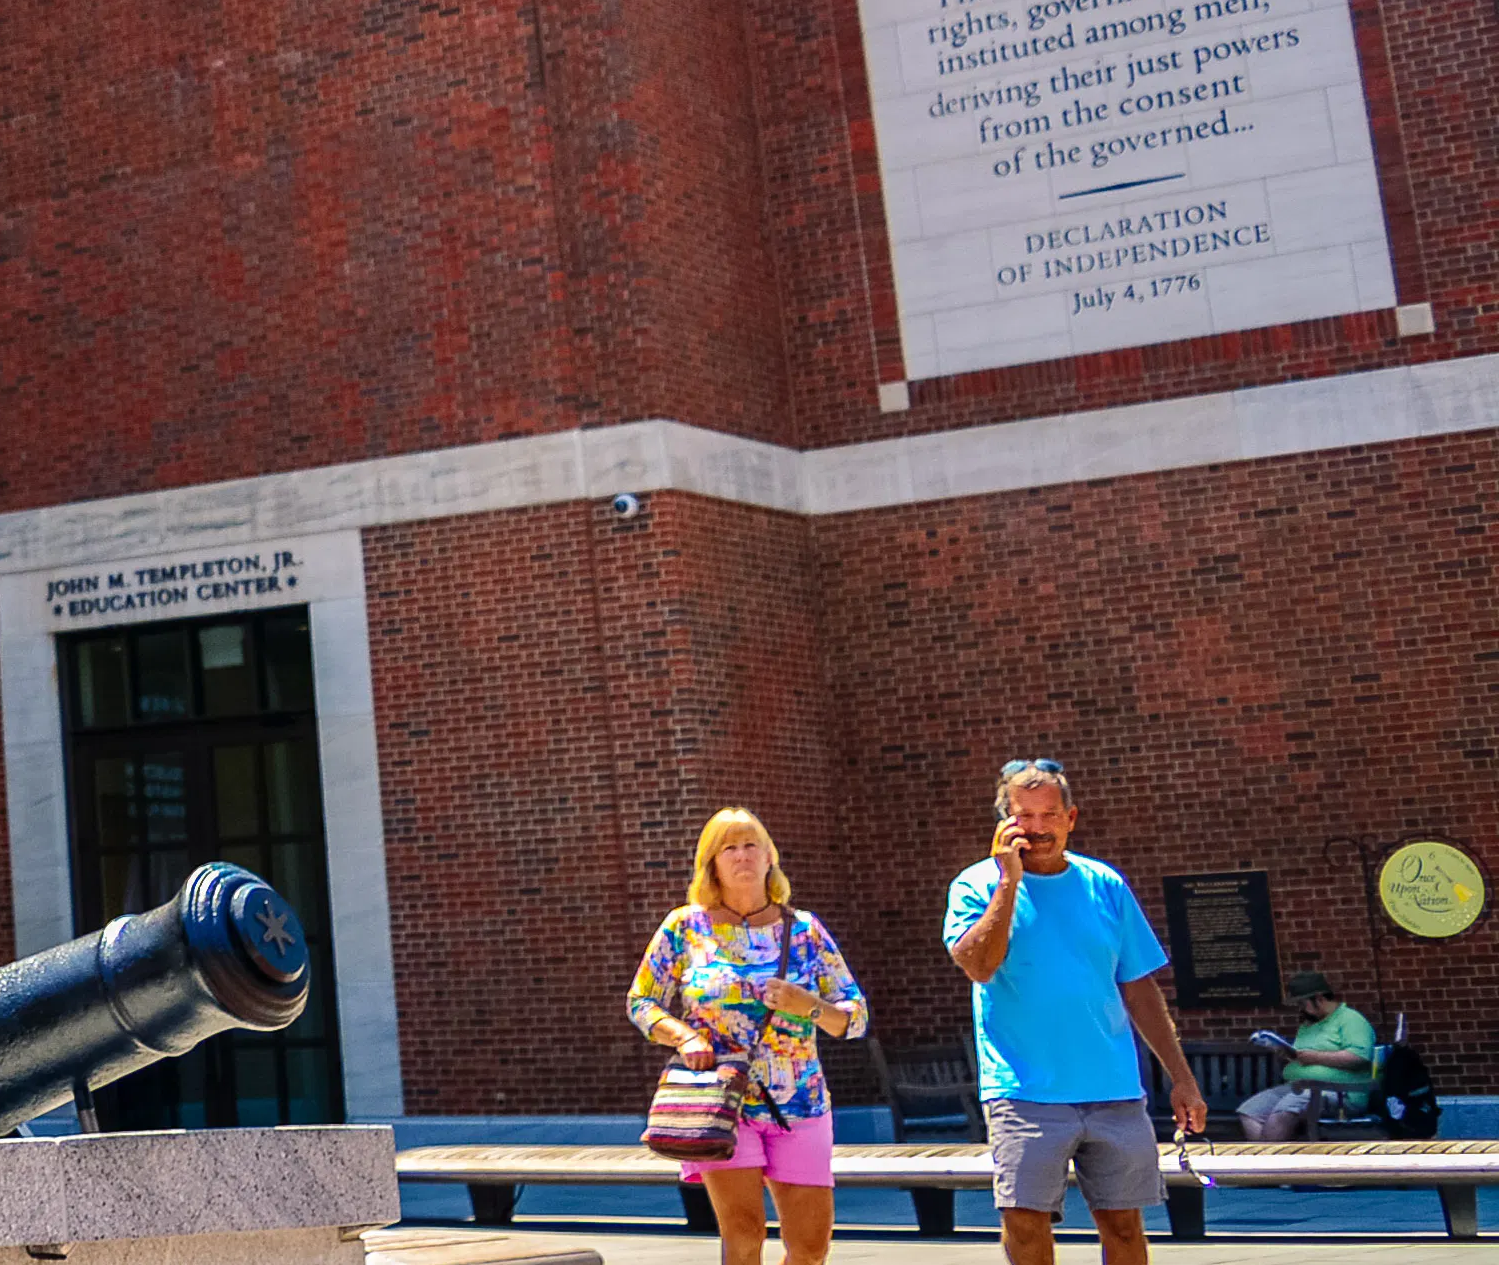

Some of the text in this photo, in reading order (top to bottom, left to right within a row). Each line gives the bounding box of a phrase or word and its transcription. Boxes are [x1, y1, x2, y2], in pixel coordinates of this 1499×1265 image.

[927, 9, 1017, 56] rights,
[937, 21, 1076, 75] instituted
[1084, 6, 1187, 45] among
[928, 27, 1300, 118] deriving their just powers
[978, 74, 1245, 144] from the consent
[992, 107, 1254, 177] of the governed...
[996, 222, 1270, 285] OF INDEPENDENCE
[1025, 199, 1227, 254] DECLARATION
[1072, 272, 1200, 315] July 4, 1776
[47, 551, 305, 602] JOHN M. TEMPLETON, JR.
[68, 575, 282, 618] EDUCATION CENTER
